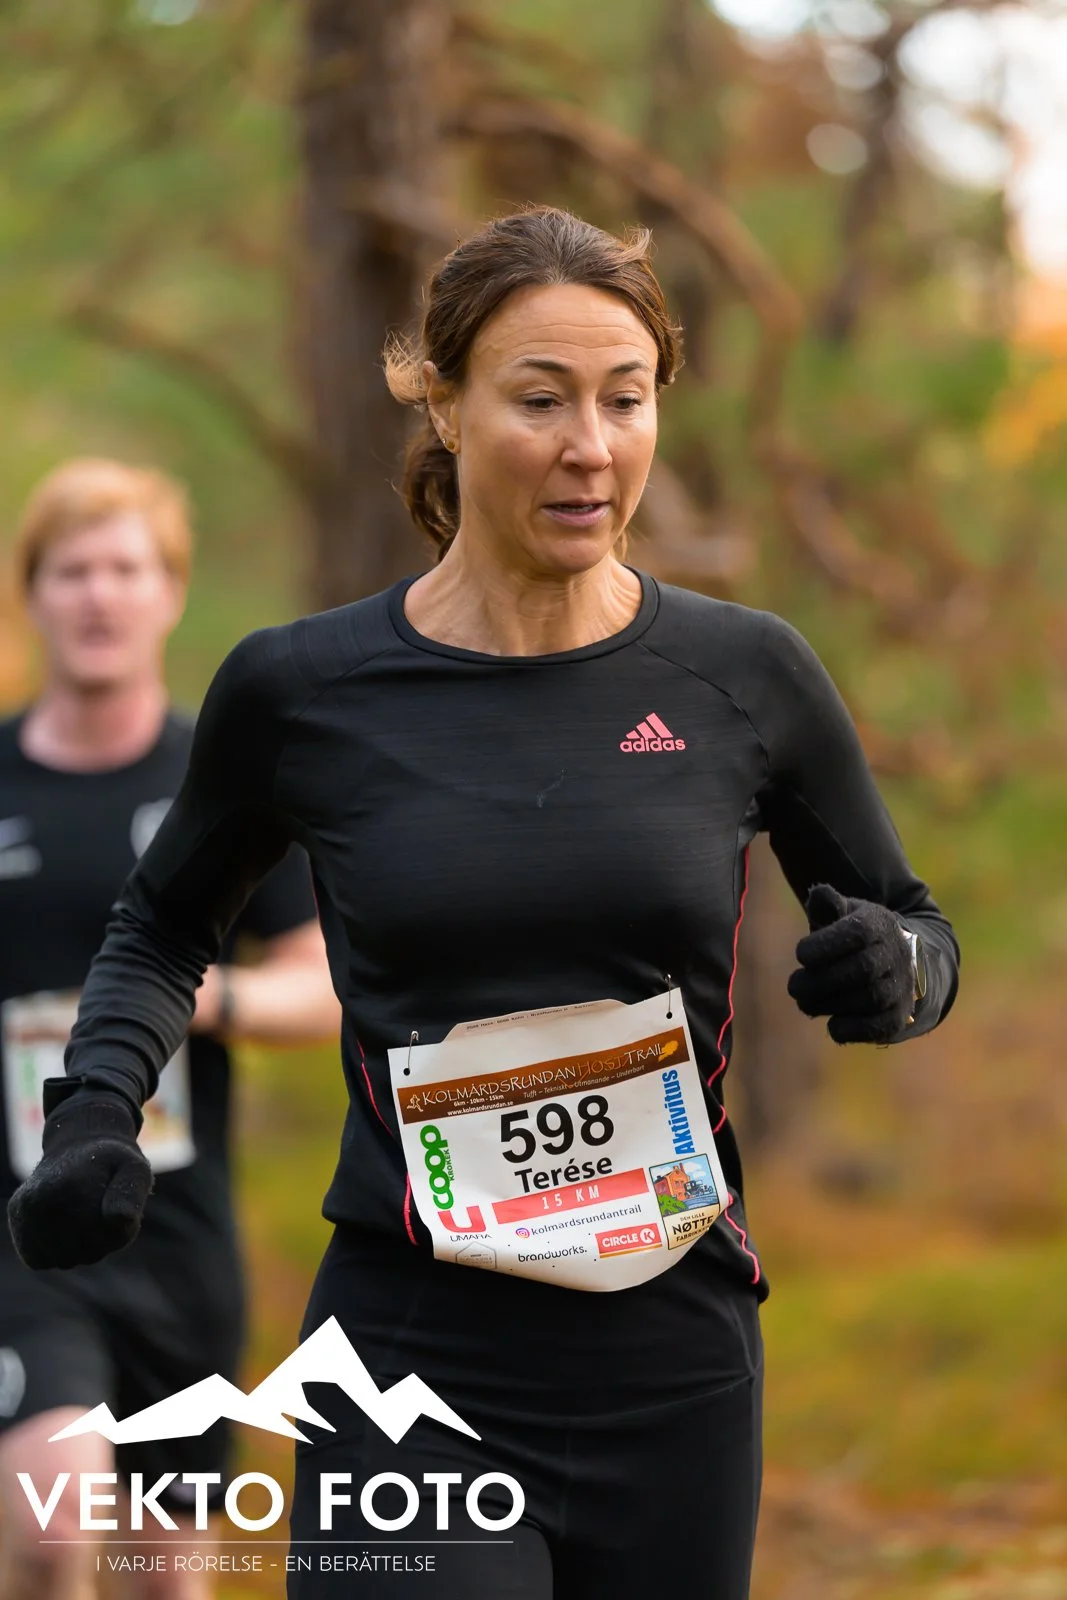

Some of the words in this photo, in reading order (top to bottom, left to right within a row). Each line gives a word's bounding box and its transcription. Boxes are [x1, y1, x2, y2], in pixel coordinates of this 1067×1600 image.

[620, 737, 686, 753] adidas
[447, 1100, 514, 1116] www.kolmardsrundan.se
[469, 1097, 485, 1105] 10km
[489, 1093, 505, 1101] 15km
[662, 1069, 696, 1155] Aktivitus
[501, 1095, 614, 1163] 598
[420, 1125, 454, 1210] coop
[514, 1157, 613, 1193] Terése
[531, 1204, 642, 1236] kolmardsrundantrail
[602, 1233, 639, 1248] CIRCLE
[518, 1245, 588, 1263] brandworks.
